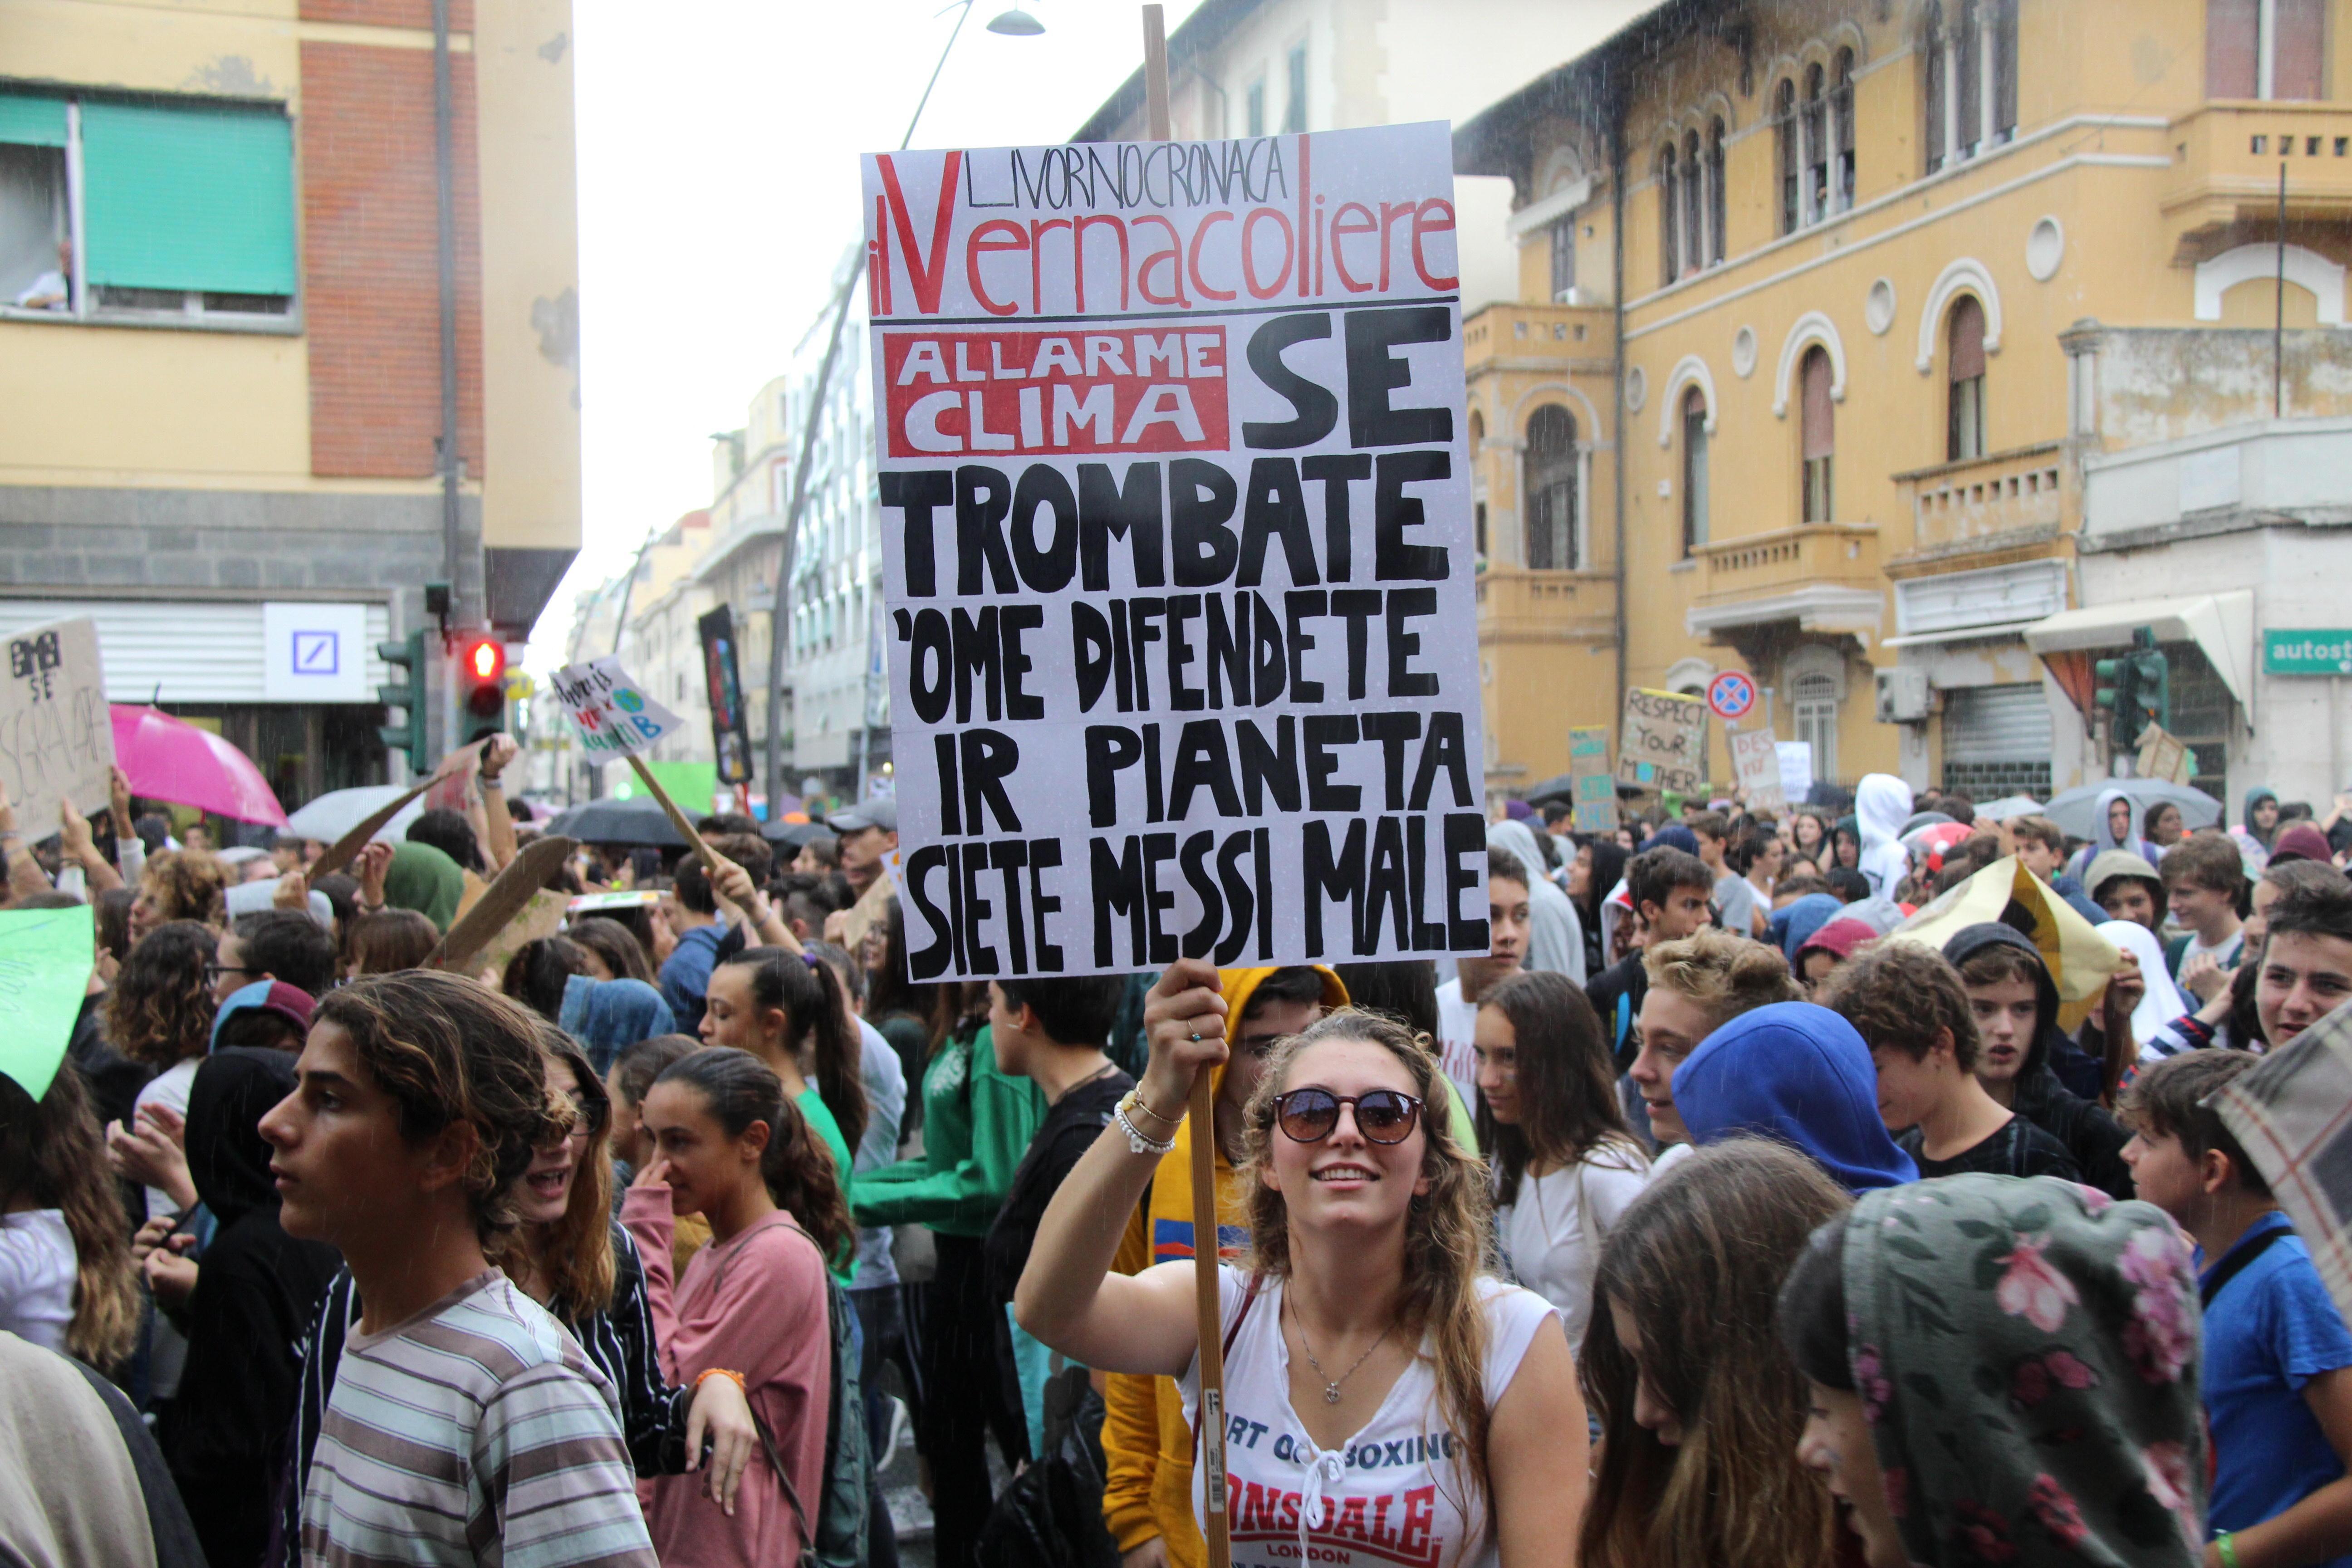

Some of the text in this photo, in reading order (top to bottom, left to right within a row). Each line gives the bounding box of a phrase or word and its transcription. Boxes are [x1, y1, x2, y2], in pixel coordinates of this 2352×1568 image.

[876, 134, 1459, 315] Vernacoliere
[897, 332, 1224, 385] ALLARME
[1242, 307, 1454, 449] SE
[904, 384, 1207, 451] CLIMA
[879, 451, 1451, 597] TROMBATE
[1071, 587, 1440, 713] DIFENDETE
[1628, 689, 1707, 726] RESPECT
[1637, 725, 1686, 756] YOUR
[934, 711, 1474, 836] IR PIANETA
[906, 813, 1490, 980] SIETE MESSI MALE
[1225, 1412, 1269, 1449] RT
[1266, 1544, 1350, 1565] LONDON
